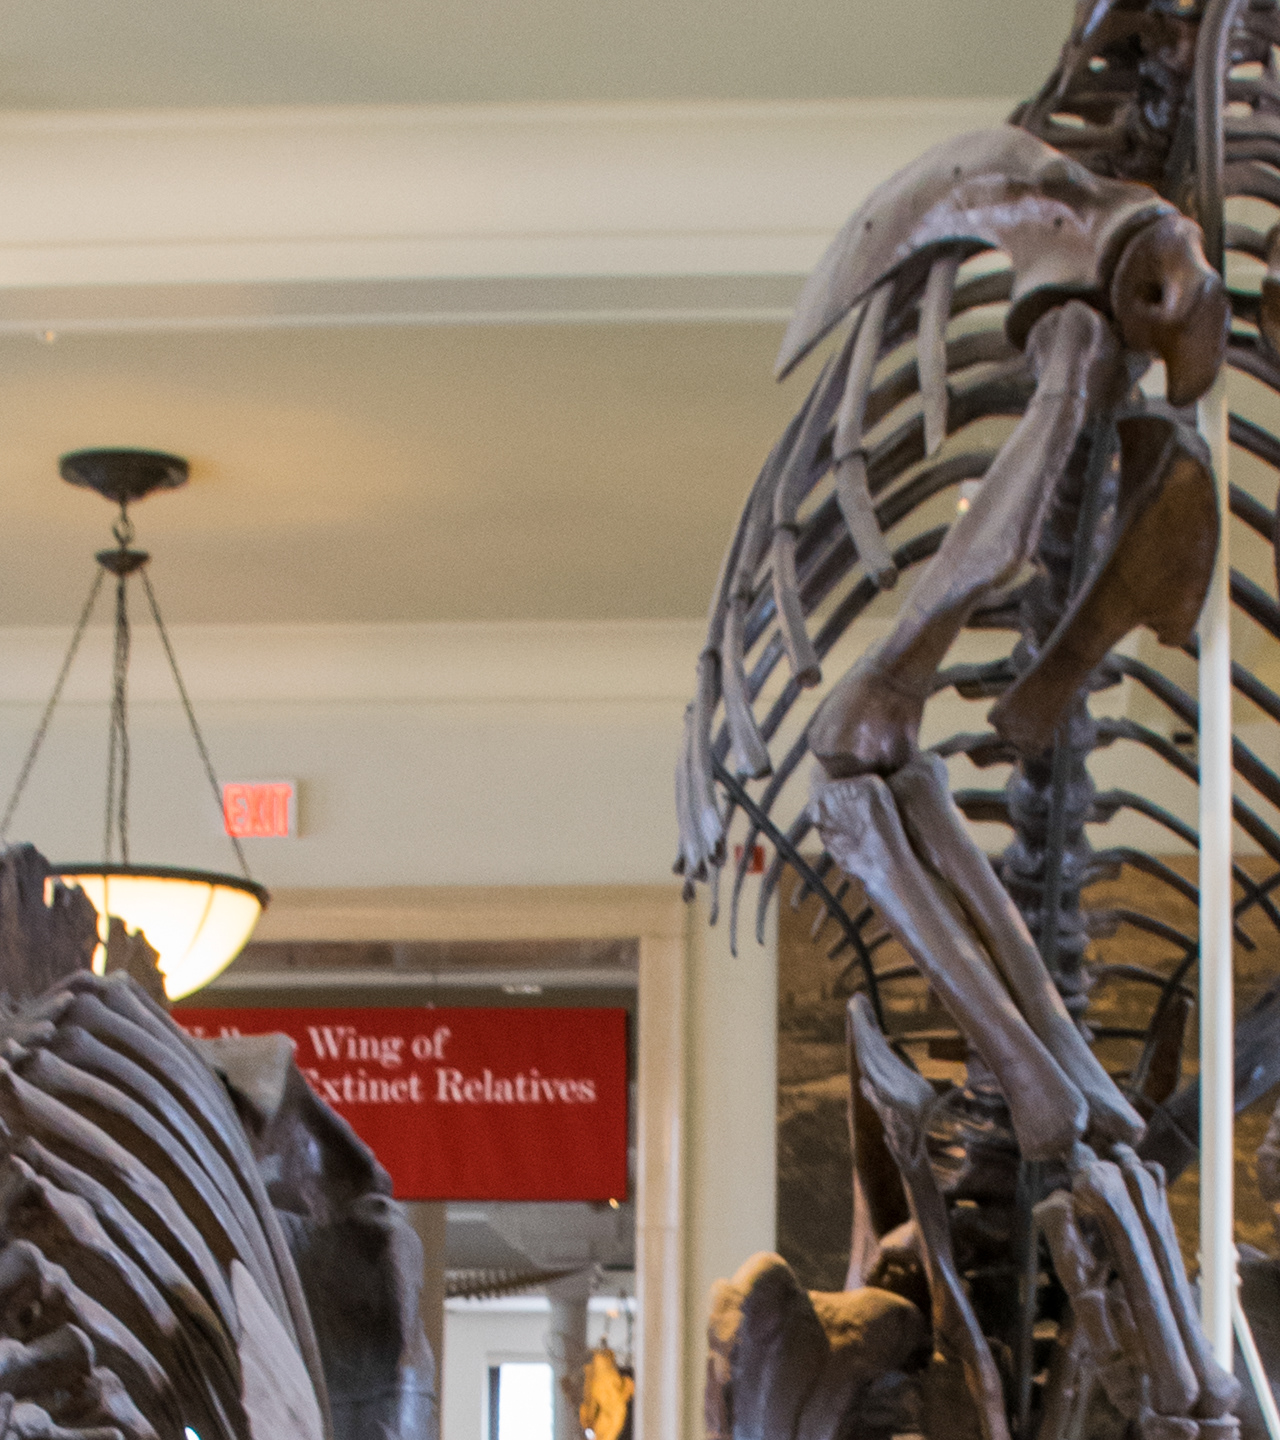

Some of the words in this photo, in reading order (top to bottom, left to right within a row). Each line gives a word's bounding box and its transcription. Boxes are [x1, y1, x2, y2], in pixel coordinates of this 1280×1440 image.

[223, 783, 293, 838] EXIT
[307, 1025, 404, 1069] Wing
[411, 1025, 451, 1060] of
[306, 1066, 422, 1104] xtinct
[435, 1066, 597, 1104] Relatives
